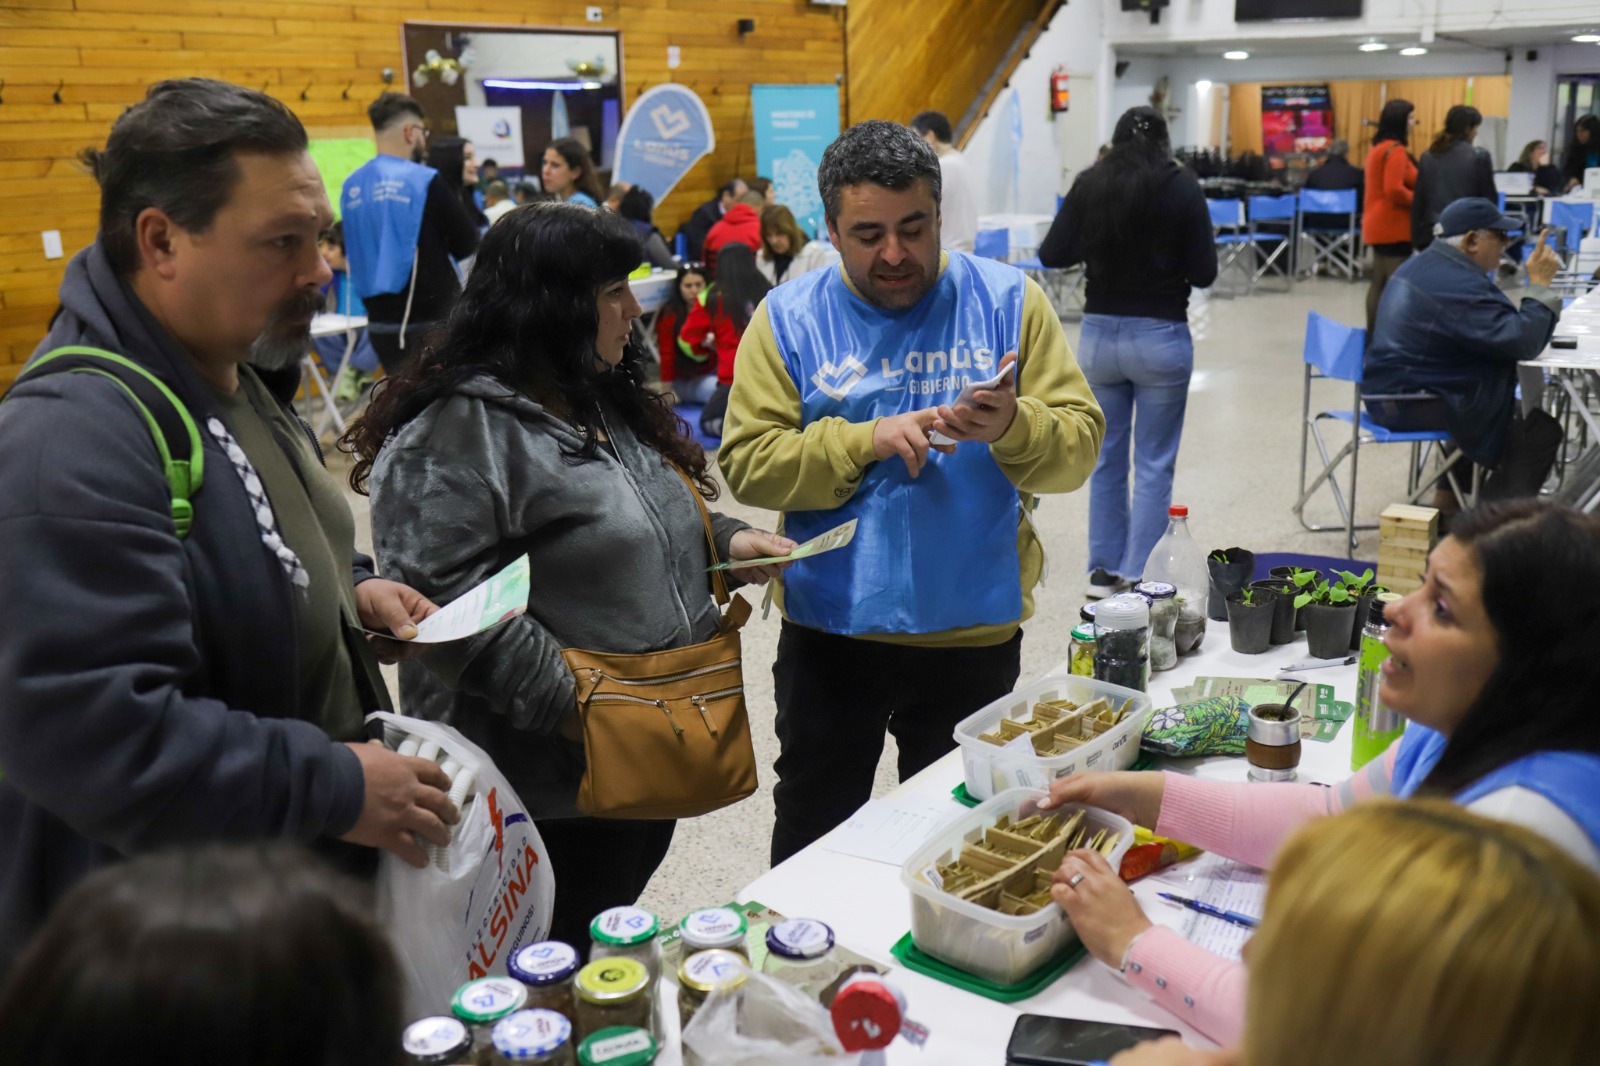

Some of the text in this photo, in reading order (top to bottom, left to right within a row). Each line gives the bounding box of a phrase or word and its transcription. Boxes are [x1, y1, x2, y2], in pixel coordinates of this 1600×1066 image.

[881, 339, 993, 378] Lanús
[465, 836, 527, 962] ELECTRICIDAD
[468, 843, 539, 981] ALSINA
